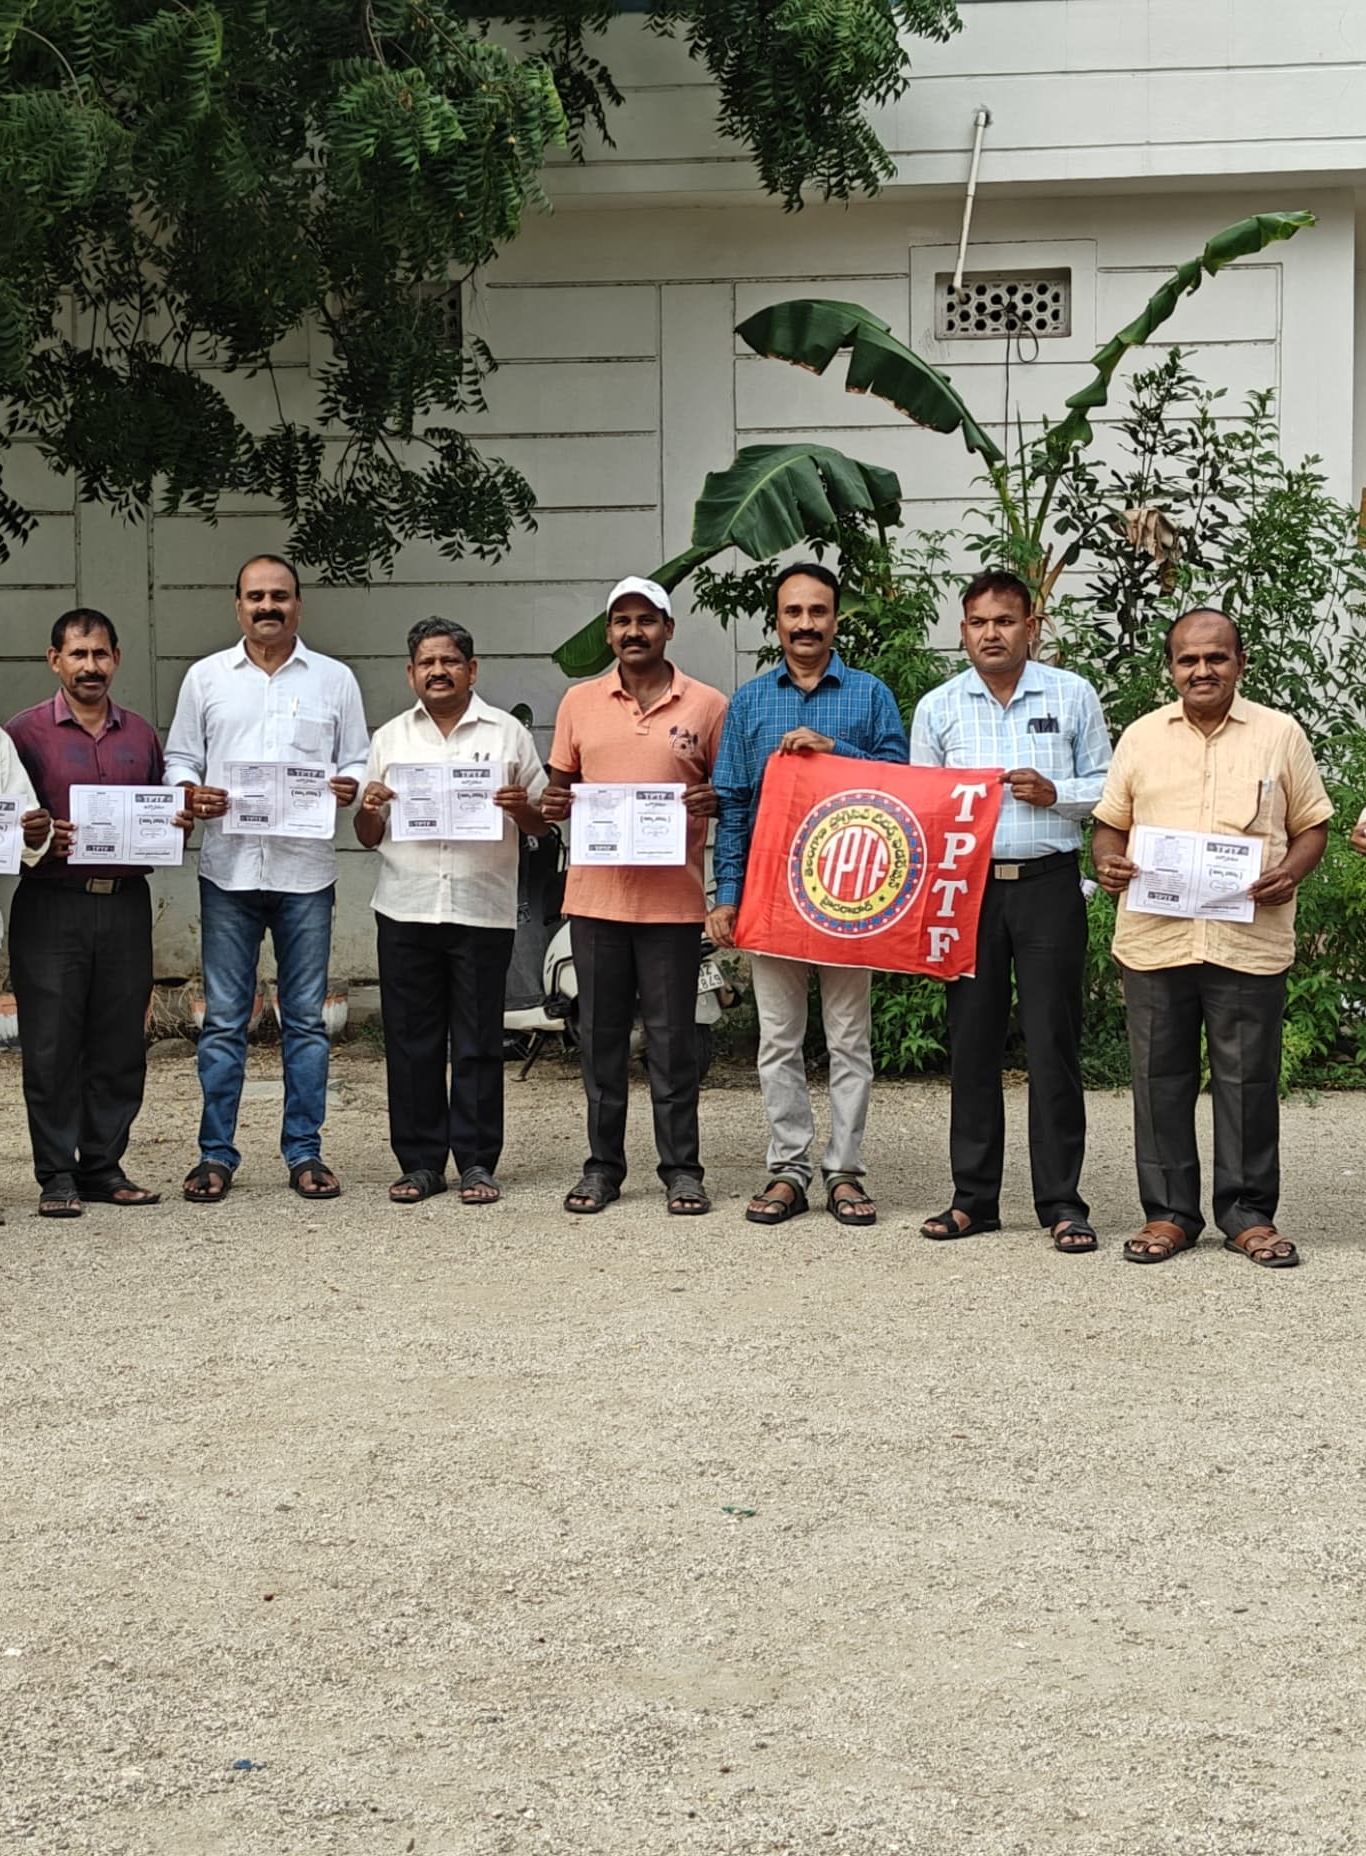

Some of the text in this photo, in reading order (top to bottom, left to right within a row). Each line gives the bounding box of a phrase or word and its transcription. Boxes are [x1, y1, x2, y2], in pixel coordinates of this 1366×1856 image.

[804, 828, 827, 877] తెలంగాణ
[821, 826, 889, 900] TPTF
[926, 783, 987, 962] TPTF
